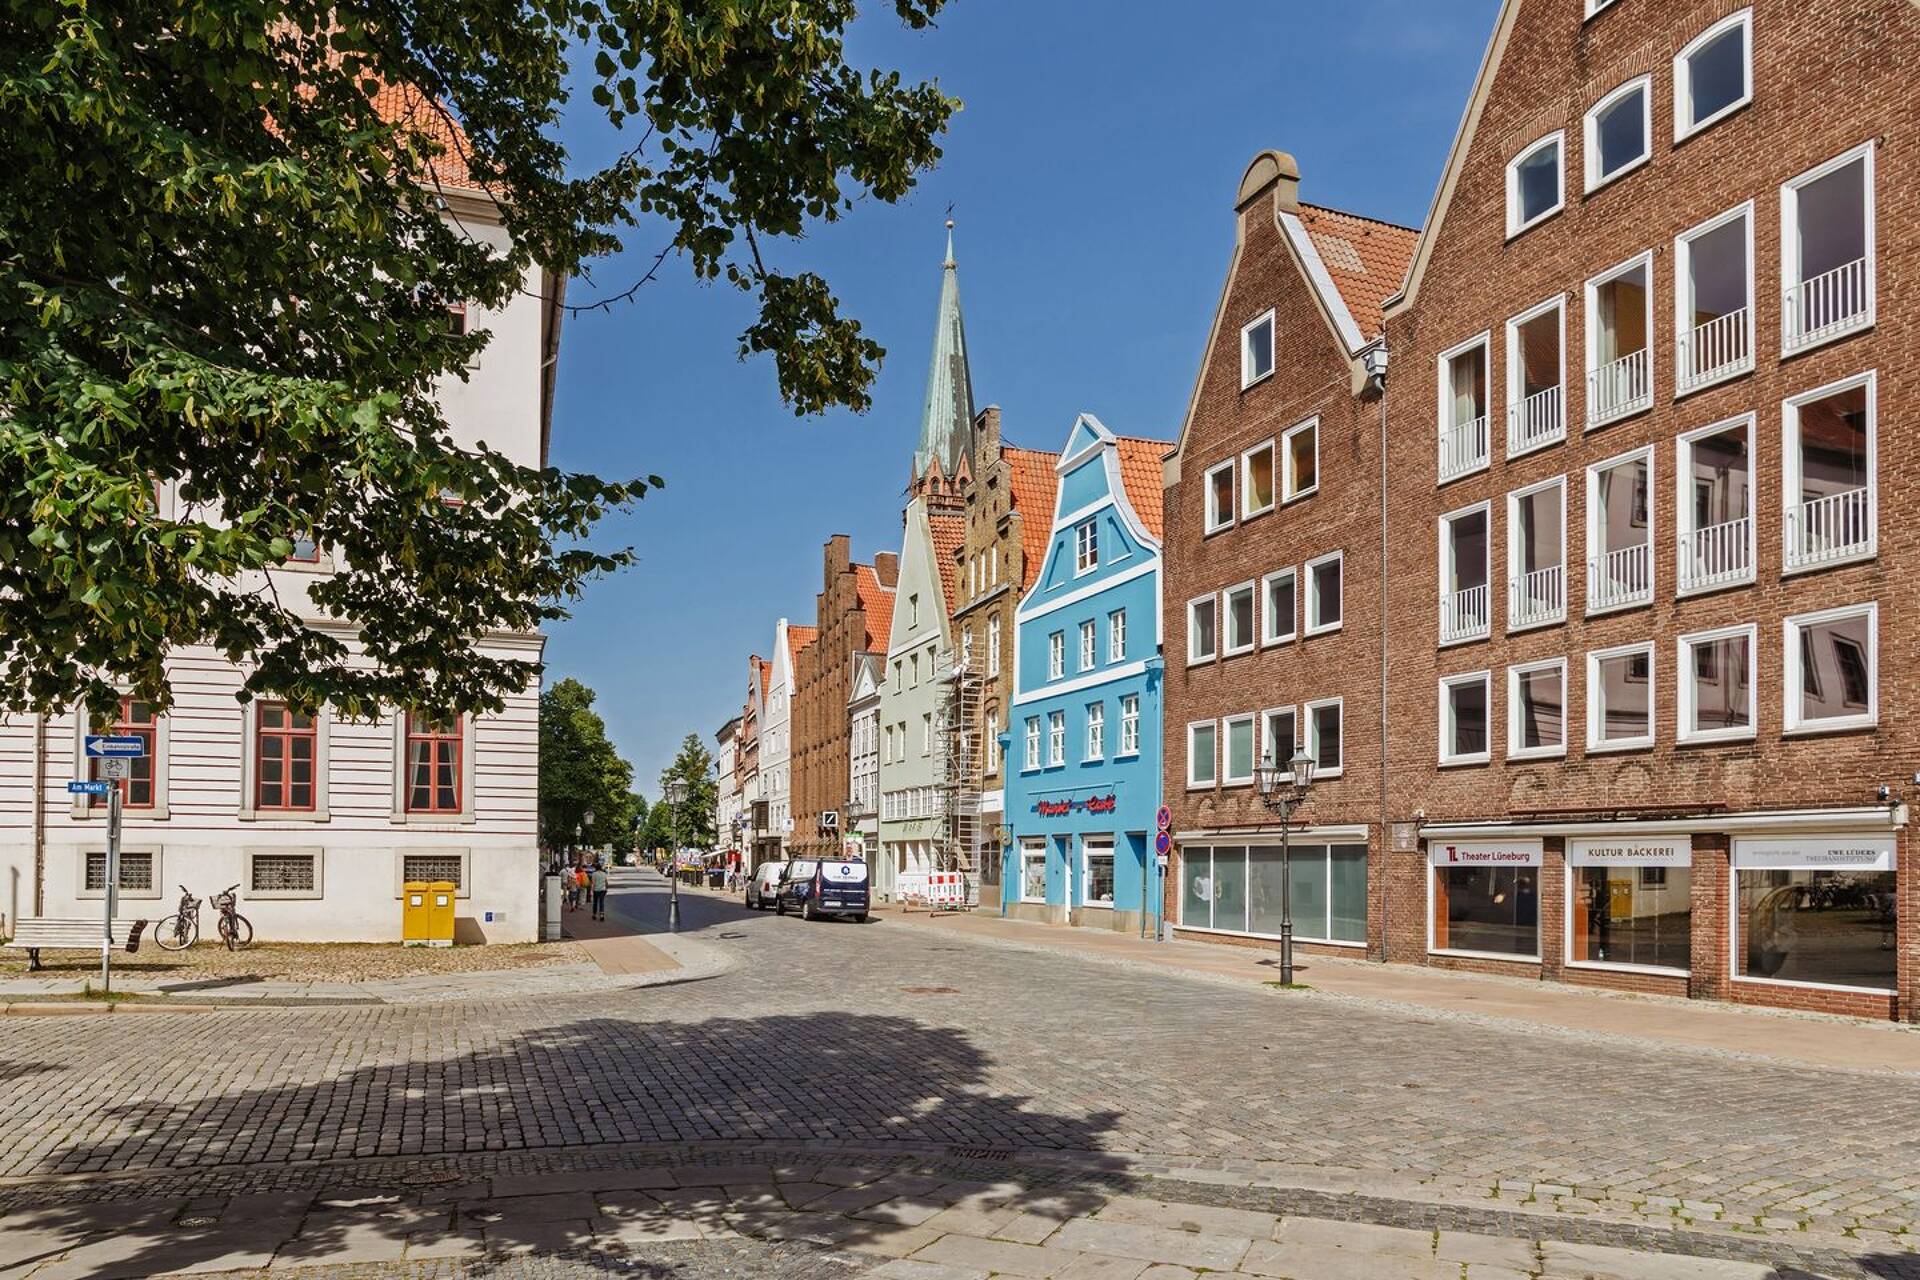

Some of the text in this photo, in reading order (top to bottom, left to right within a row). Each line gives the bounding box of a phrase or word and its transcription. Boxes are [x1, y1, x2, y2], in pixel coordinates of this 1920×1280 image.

[84, 783, 103, 791] Markt
[1462, 851, 1530, 862] Theater Lüneburg
[1588, 848, 1624, 857] KULTUR
